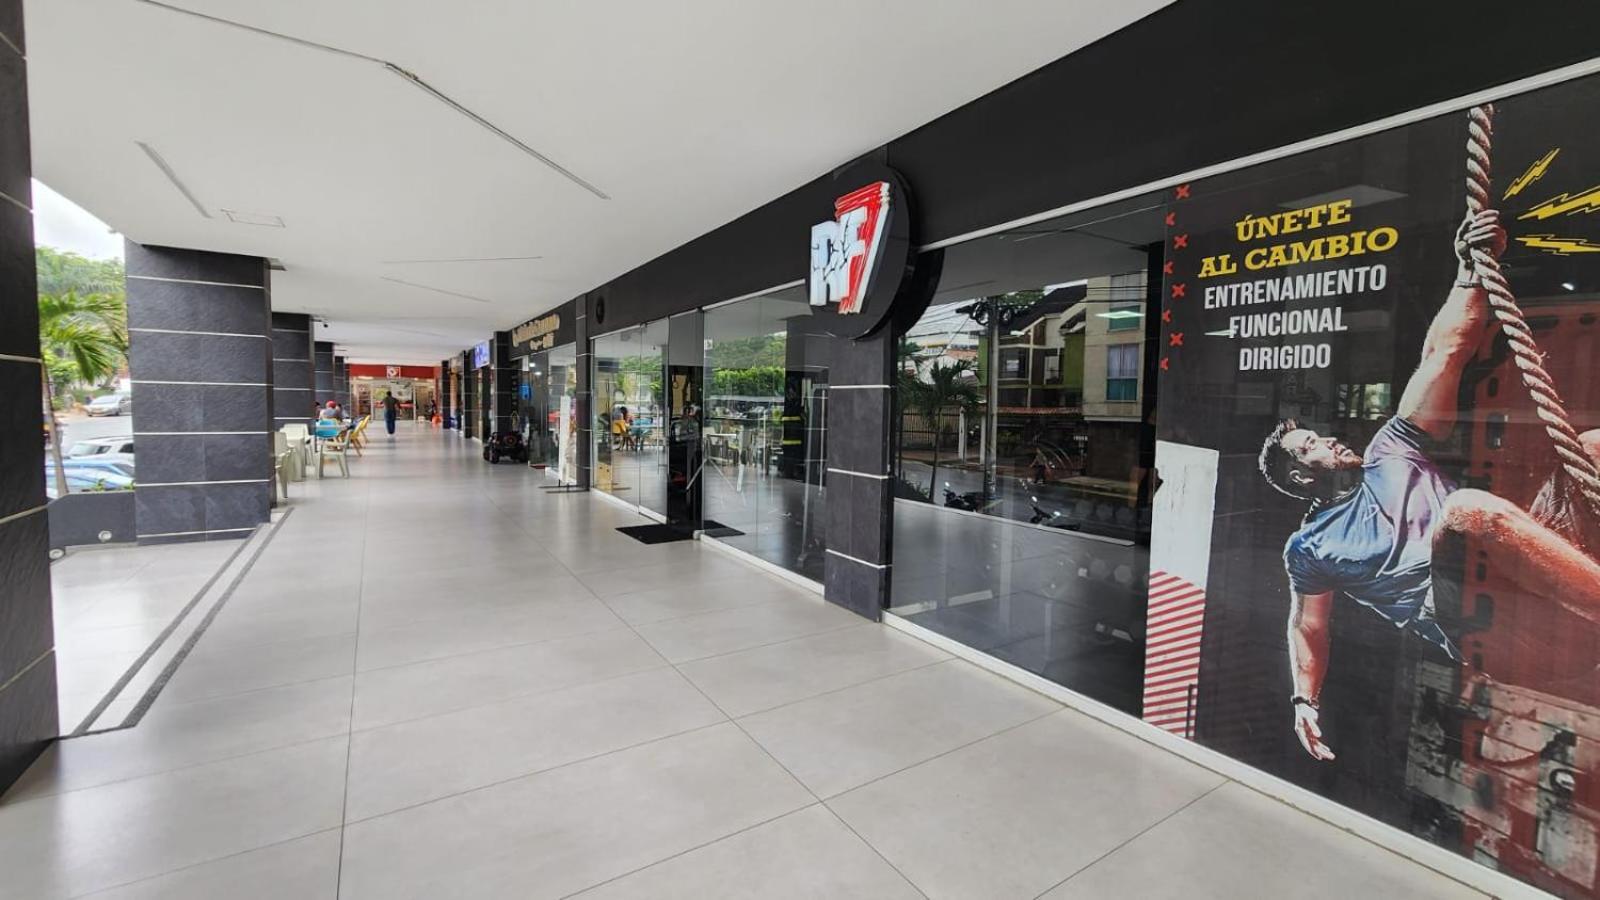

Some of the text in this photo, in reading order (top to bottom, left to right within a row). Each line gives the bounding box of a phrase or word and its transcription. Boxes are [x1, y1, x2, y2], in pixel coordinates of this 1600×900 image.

[1236, 200, 1352, 242] ÚNETE
[1198, 227, 1399, 278] AL CAMBIO
[1204, 264, 1387, 309] ENTRENAMIENTO
[1229, 307, 1348, 338] FUNCIONAL
[1239, 344, 1331, 371] DIRIGIDO
